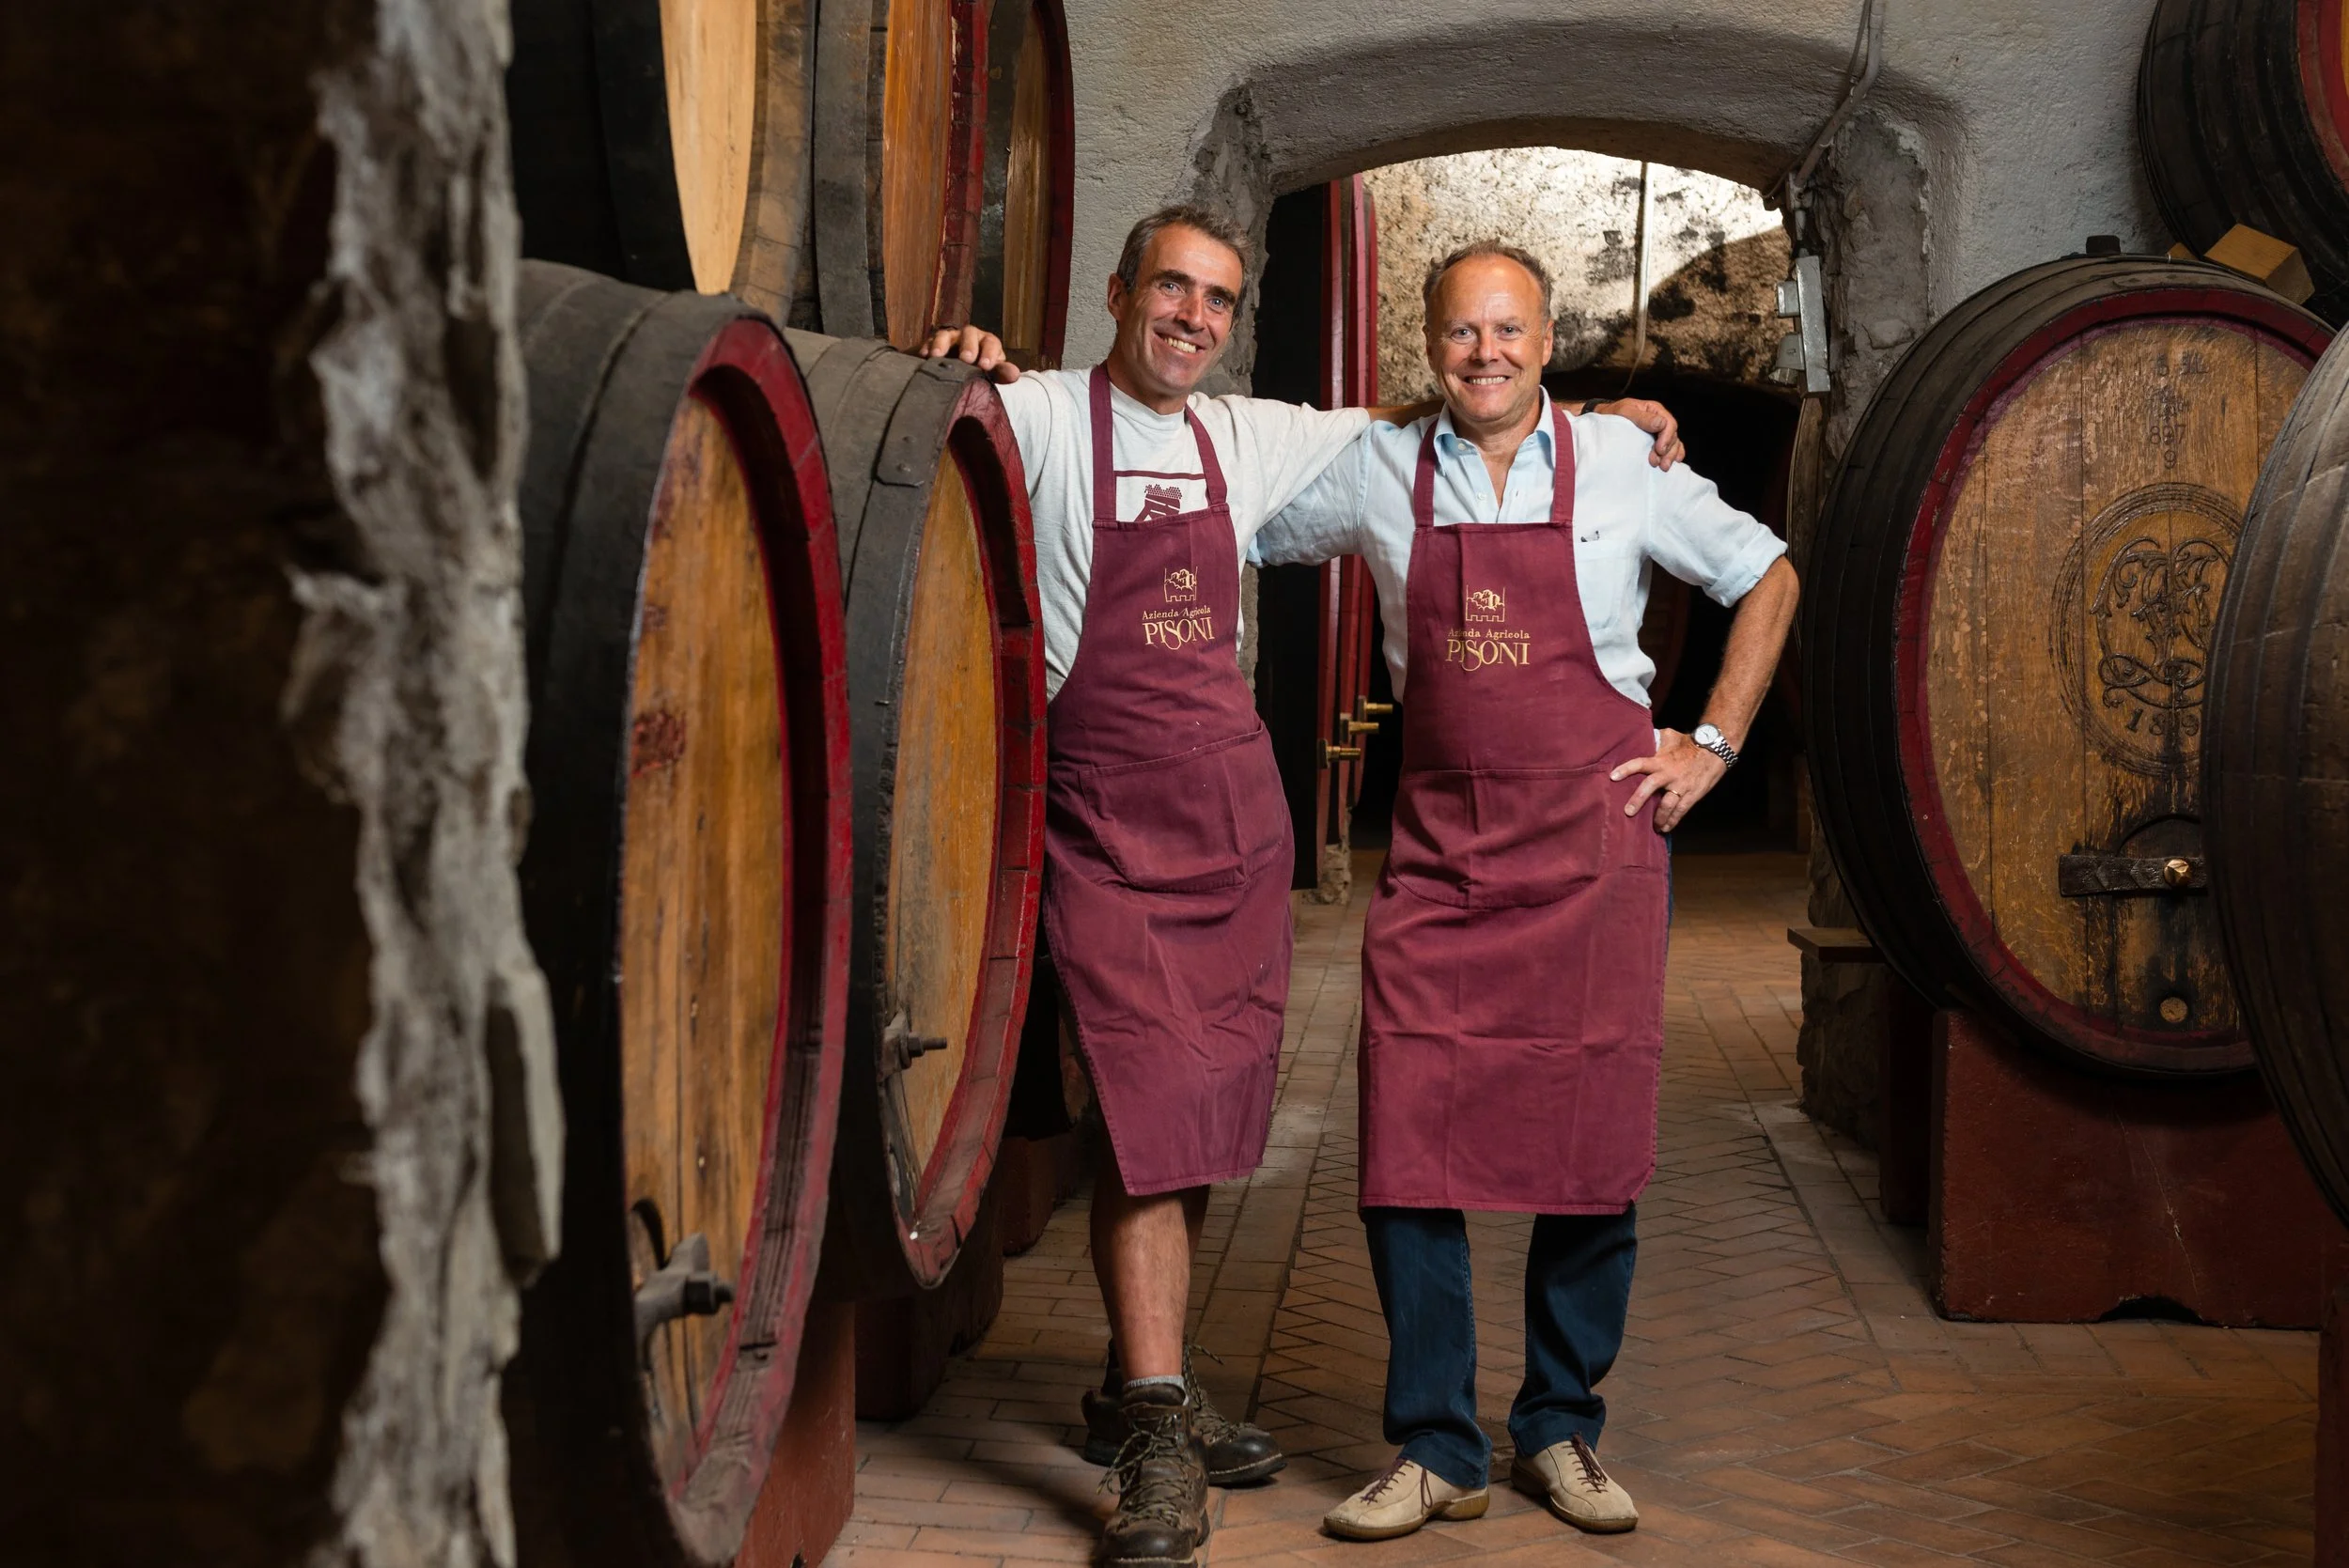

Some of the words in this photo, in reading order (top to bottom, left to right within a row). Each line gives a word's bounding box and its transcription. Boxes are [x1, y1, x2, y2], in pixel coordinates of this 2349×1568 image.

[1143, 609, 1179, 620] Azienda
[1183, 605, 1211, 618] Agricola
[1143, 616, 1215, 650] PISONI
[1486, 629, 1531, 640] Agricola
[1445, 639, 1531, 671] PISONI
[2123, 708, 2200, 737] 189
